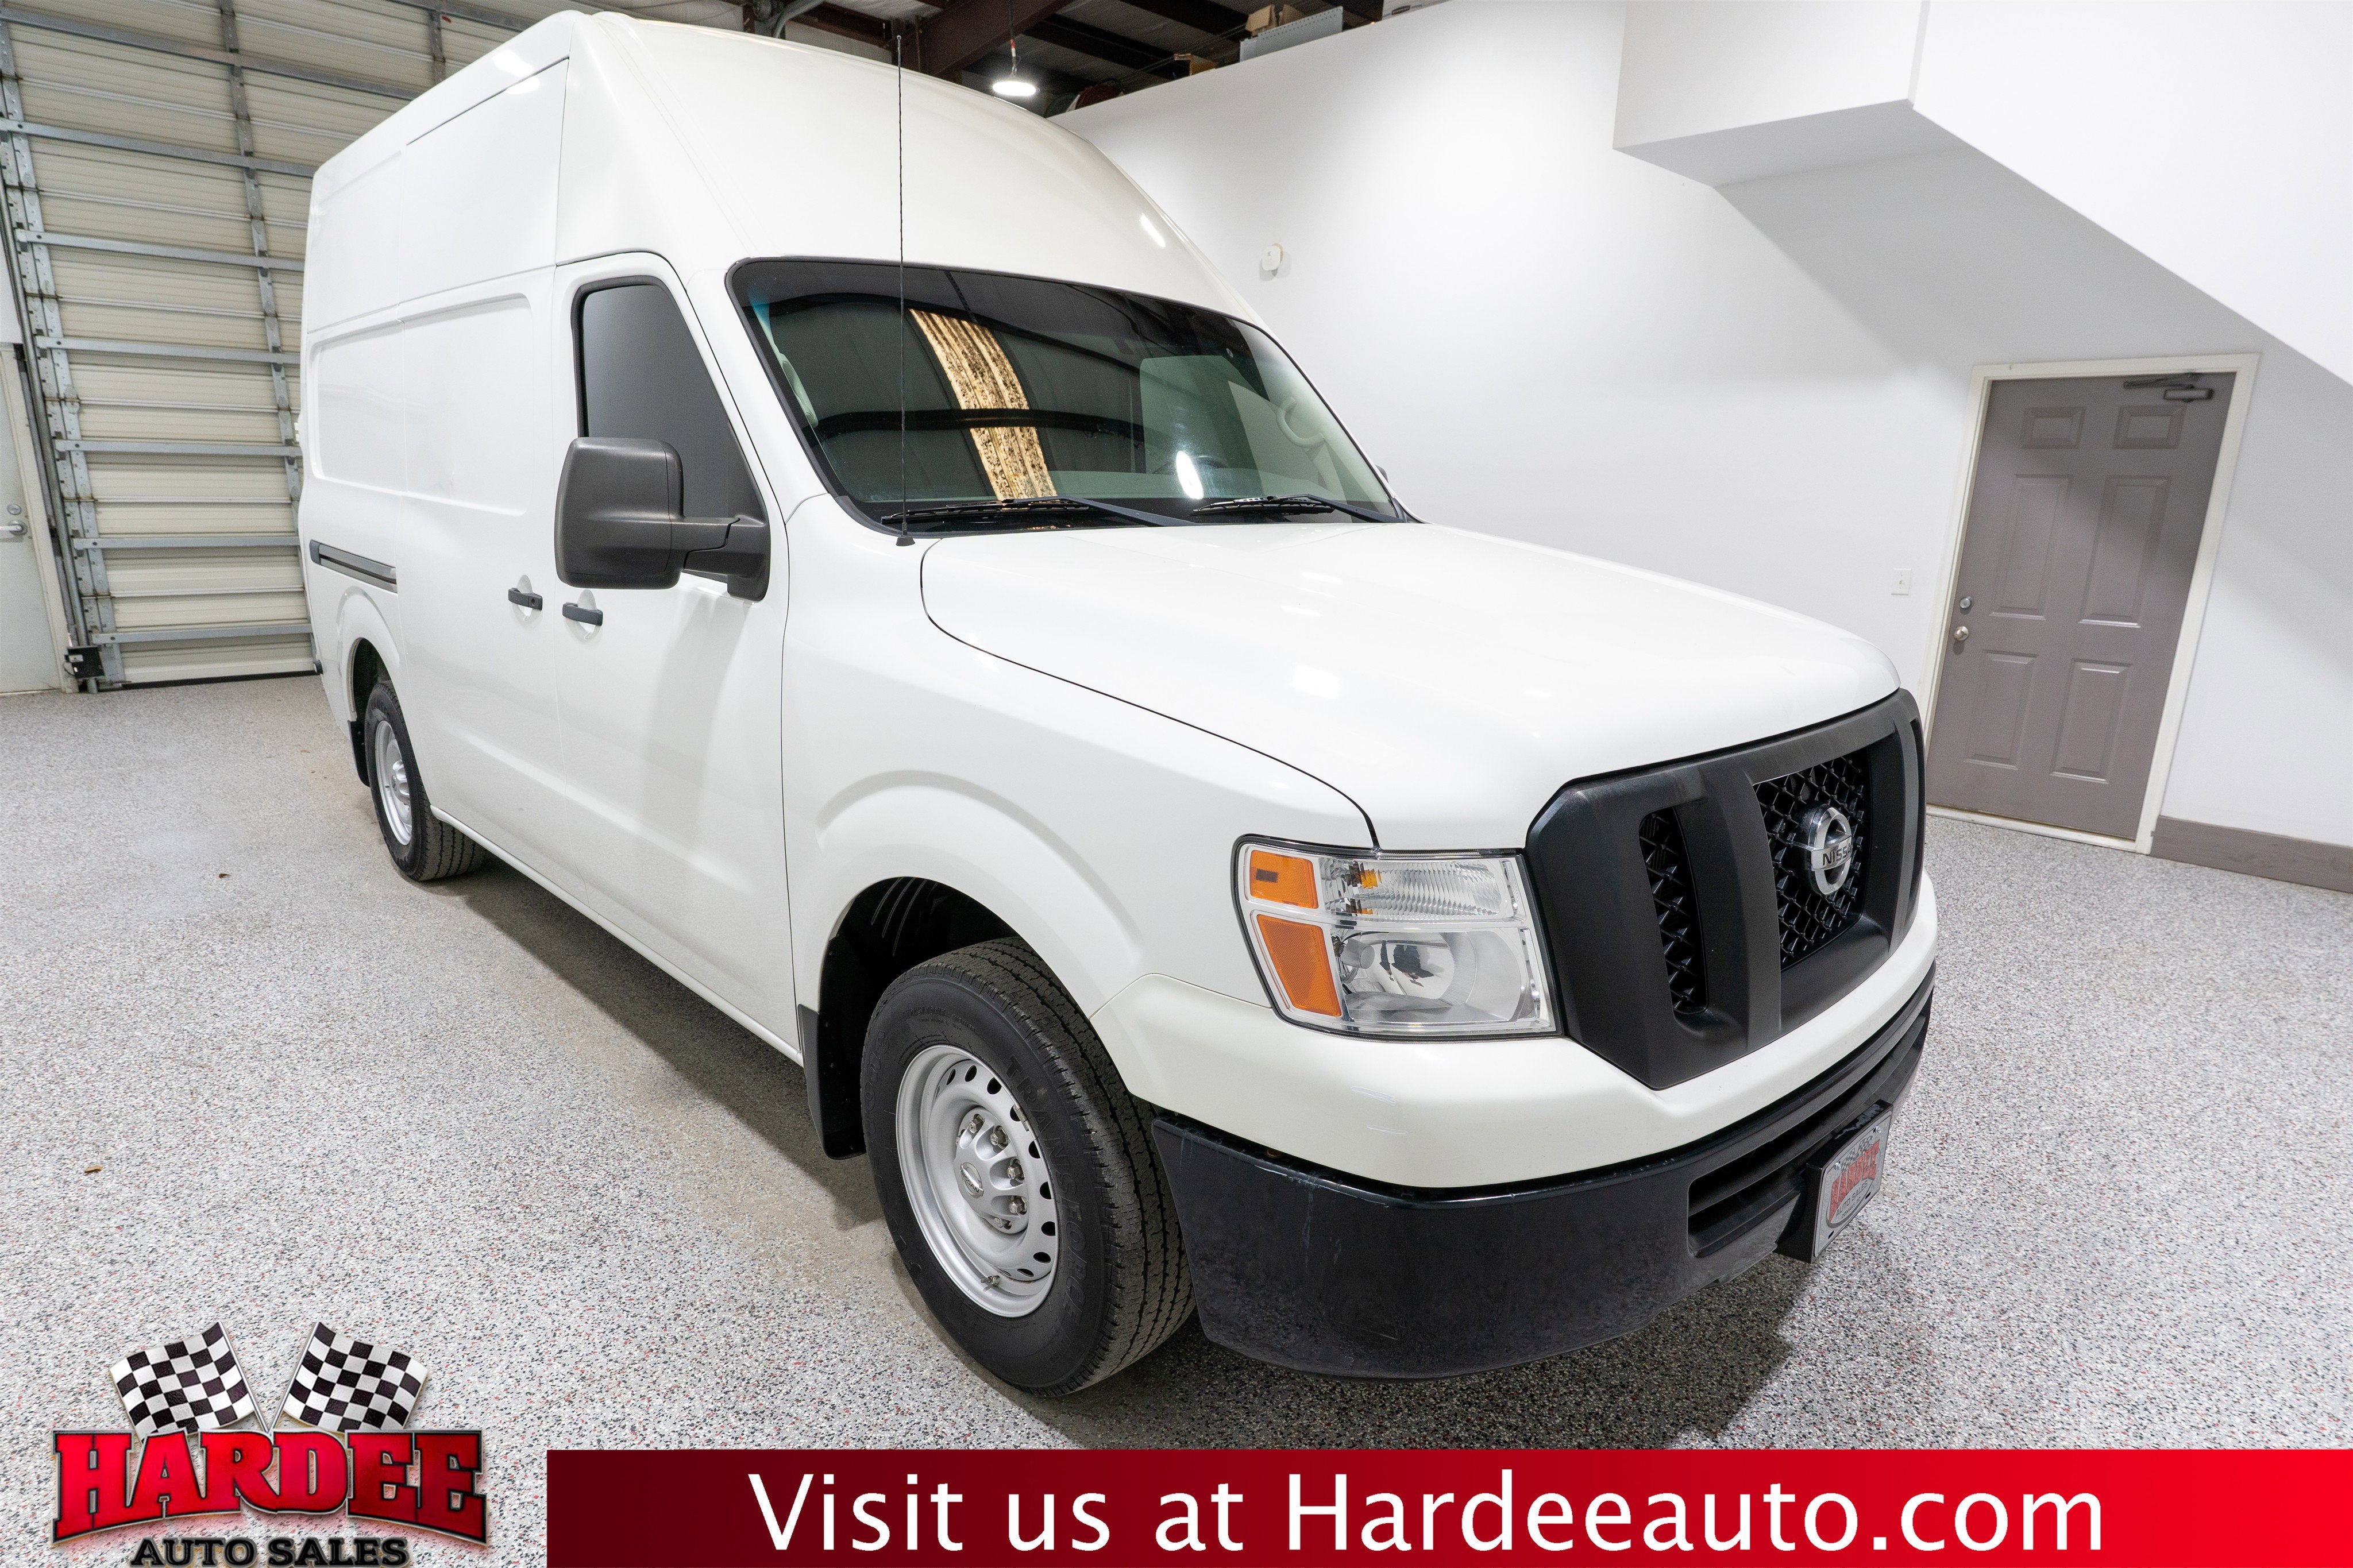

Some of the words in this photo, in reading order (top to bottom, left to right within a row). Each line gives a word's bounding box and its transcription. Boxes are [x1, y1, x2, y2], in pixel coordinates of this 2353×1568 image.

[961, 1169, 979, 1193] NISSAN
[1829, 1140, 1880, 1223] HARDEE
[1836, 1198, 1850, 1217] AUTO
[1851, 1180, 1868, 1201] SALES
